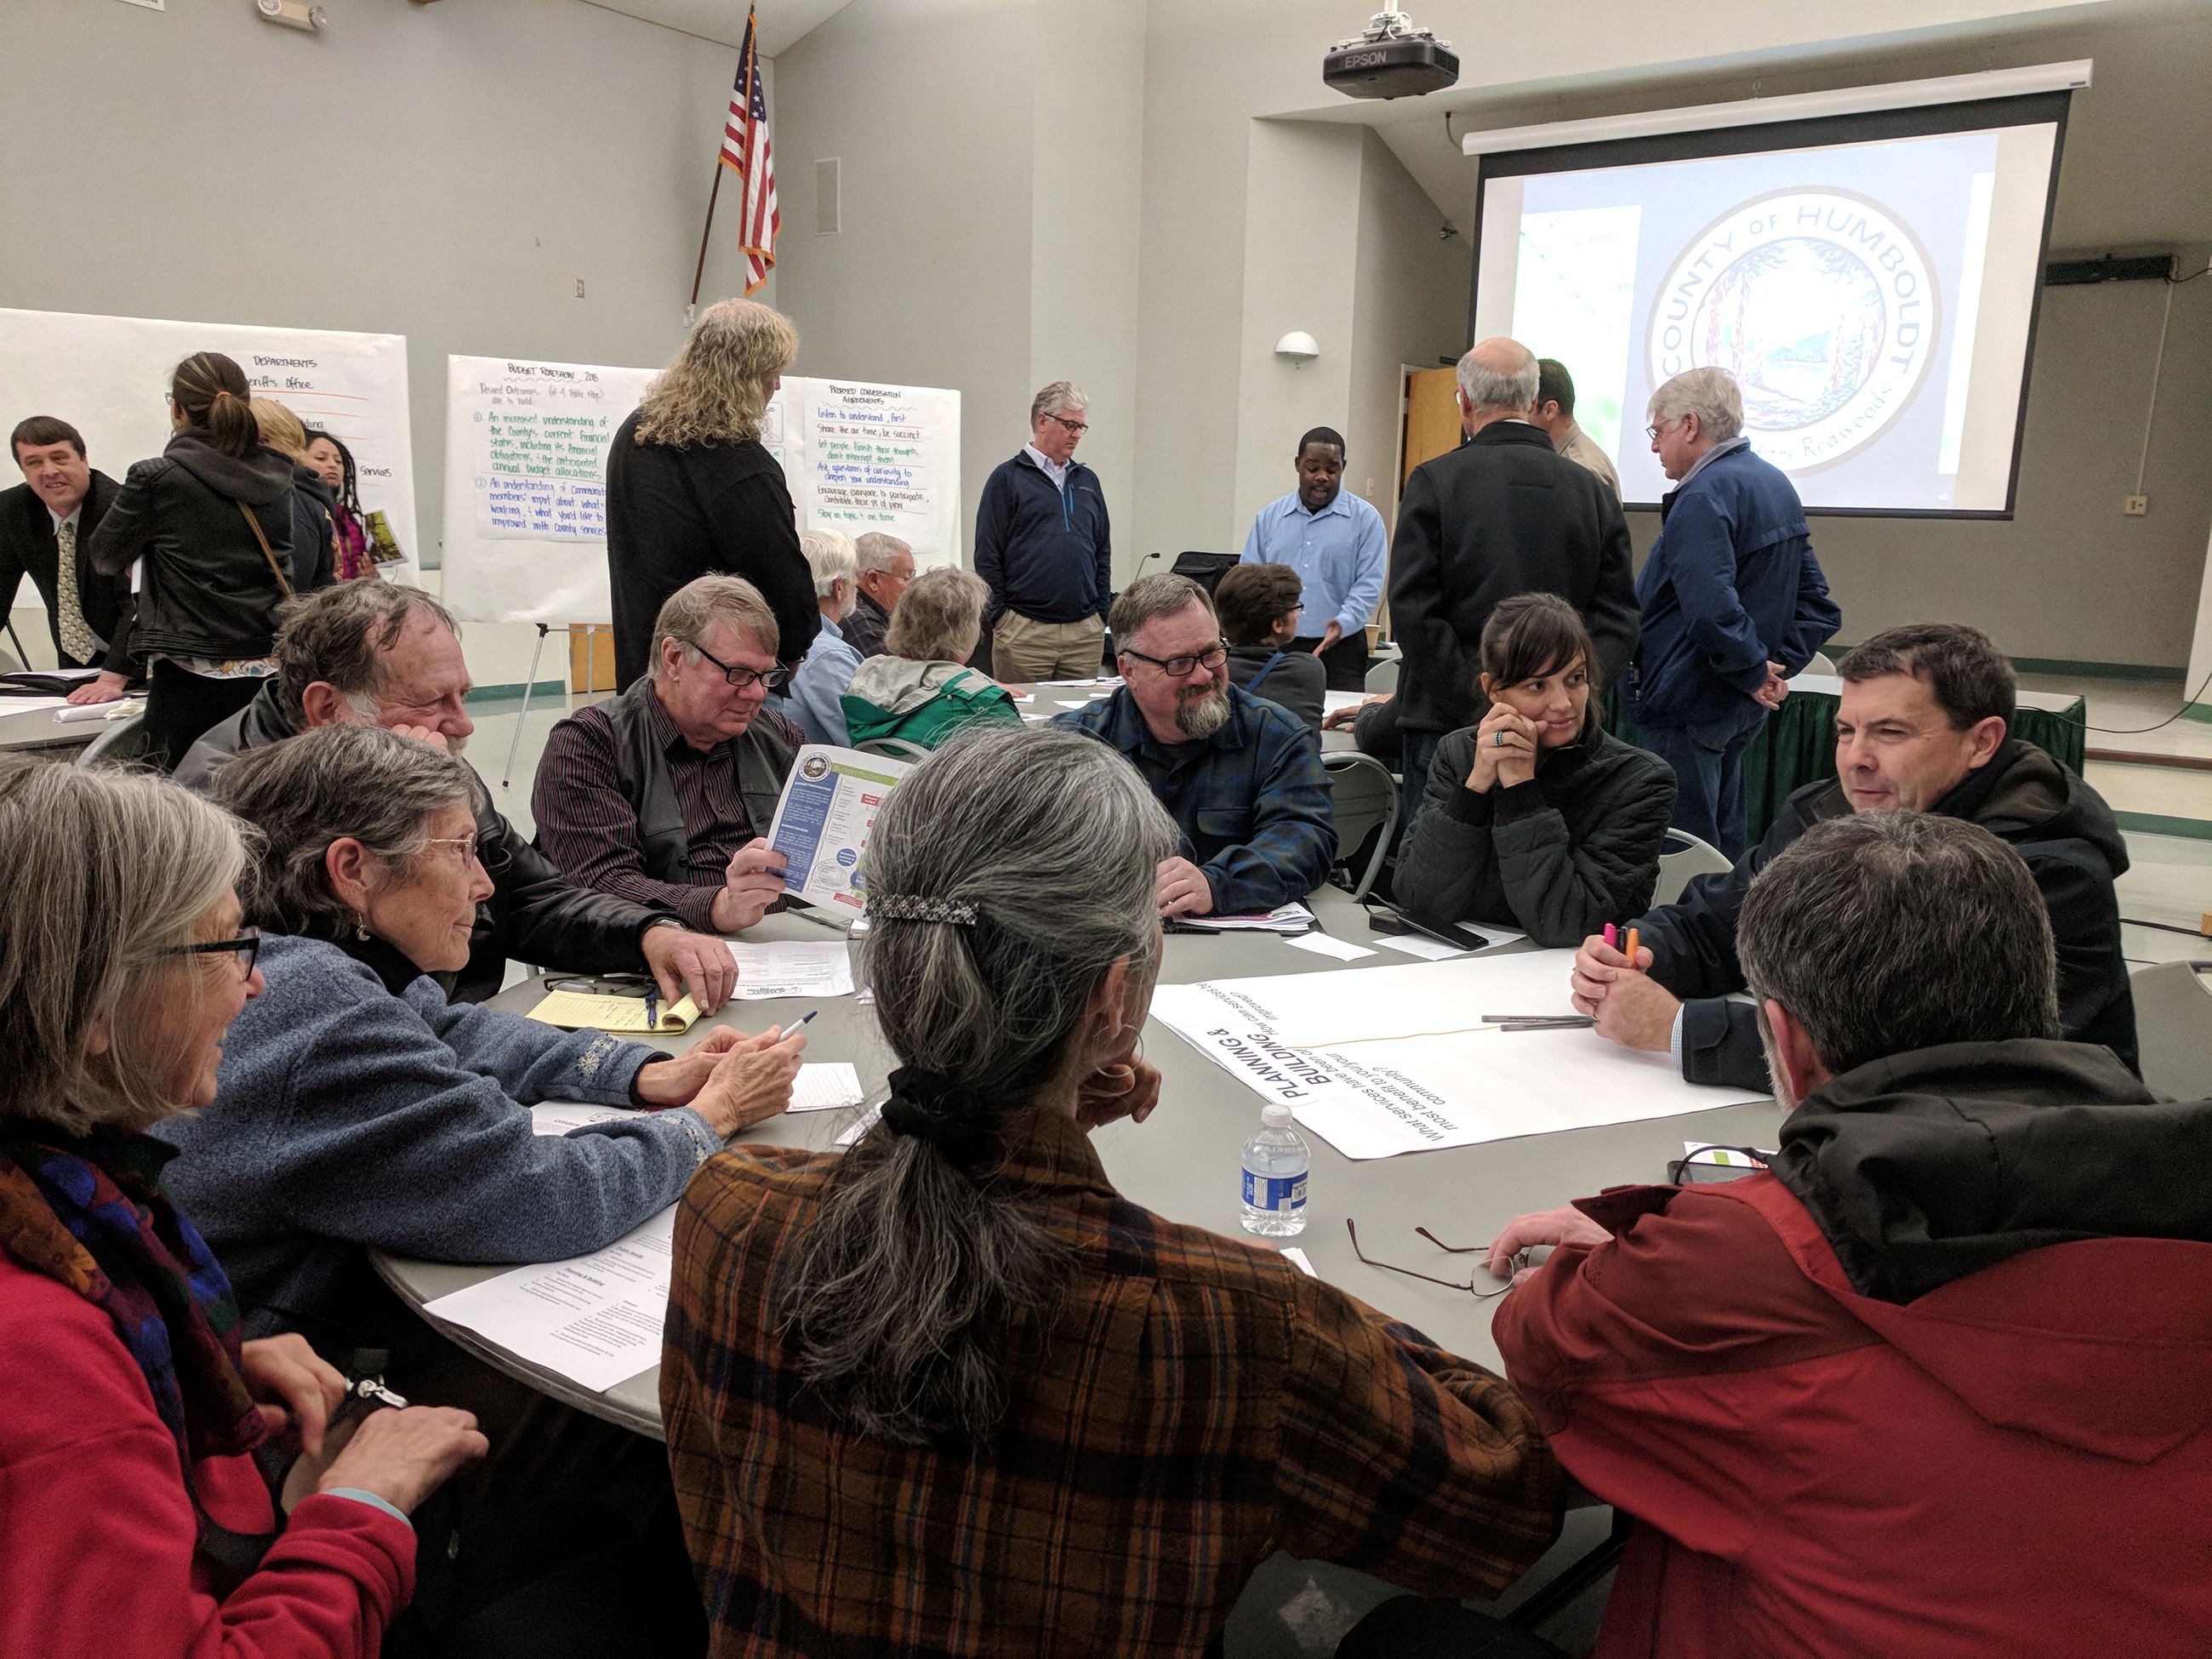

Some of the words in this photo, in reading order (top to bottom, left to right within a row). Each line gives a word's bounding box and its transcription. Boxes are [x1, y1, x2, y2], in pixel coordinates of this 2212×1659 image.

[1344, 50, 1388, 69] EPSON
[1662, 230, 1736, 377] COUNTY
[1749, 214, 1778, 236] OF
[1796, 205, 1921, 375] HUMBOLDT
[253, 356, 318, 368] DEPARTMENTS
[507, 362, 538, 376] BUDGET
[539, 367, 576, 379] ROADSHOW
[248, 375, 278, 388] eriff's
[286, 376, 314, 390] Office
[829, 385, 857, 396] PROPOSED
[859, 388, 902, 399] CONVERSATION
[488, 411, 499, 424] An
[503, 412, 539, 425] increased
[542, 415, 595, 432] understanding
[599, 415, 609, 427] of
[818, 407, 837, 419] Listen
[839, 409, 847, 419] to
[489, 425, 502, 436] the
[544, 429, 575, 440] current
[579, 430, 611, 444] financial
[817, 423, 836, 435] Share
[839, 425, 850, 435] the
[882, 427, 891, 438] be
[892, 430, 921, 440] succinct
[520, 440, 552, 453] including
[568, 442, 598, 457] financial
[830, 442, 849, 451] people
[853, 441, 873, 453] finish
[846, 452, 873, 464] interrupt
[360, 466, 392, 477] Services
[492, 462, 521, 474] annual
[526, 462, 552, 478] budget
[832, 464, 863, 475] questions
[864, 464, 872, 476] of
[904, 468, 913, 478] to
[489, 476, 500, 488] An
[503, 477, 556, 497] understanding
[824, 471, 847, 484] deepen
[866, 475, 910, 489] understanding
[531, 493, 551, 507] input
[556, 497, 576, 508] about
[534, 507, 552, 518] what
[579, 510, 593, 522] like
[595, 512, 605, 522] to
[879, 512, 897, 522] time
[491, 517, 527, 530] improved
[532, 520, 550, 532] with
[1207, 987, 1243, 1010] services
[1229, 991, 1280, 1021] improved?
[1239, 1010, 1259, 1022] can
[1206, 1028, 1230, 1036] &
[1253, 1021, 1280, 1035] How
[1218, 1037, 1310, 1098] PLANNING
[1246, 1034, 1333, 1085] BUILDING
[1308, 1055, 1339, 1074] been
[1335, 1072, 1366, 1089] have
[1370, 1077, 1387, 1086] to
[1371, 1066, 1446, 1106] community?
[1361, 1087, 1412, 1120] services
[1382, 1084, 1428, 1112] benefit
[1419, 1110, 1459, 1131] most
[1405, 1119, 1445, 1142] What
